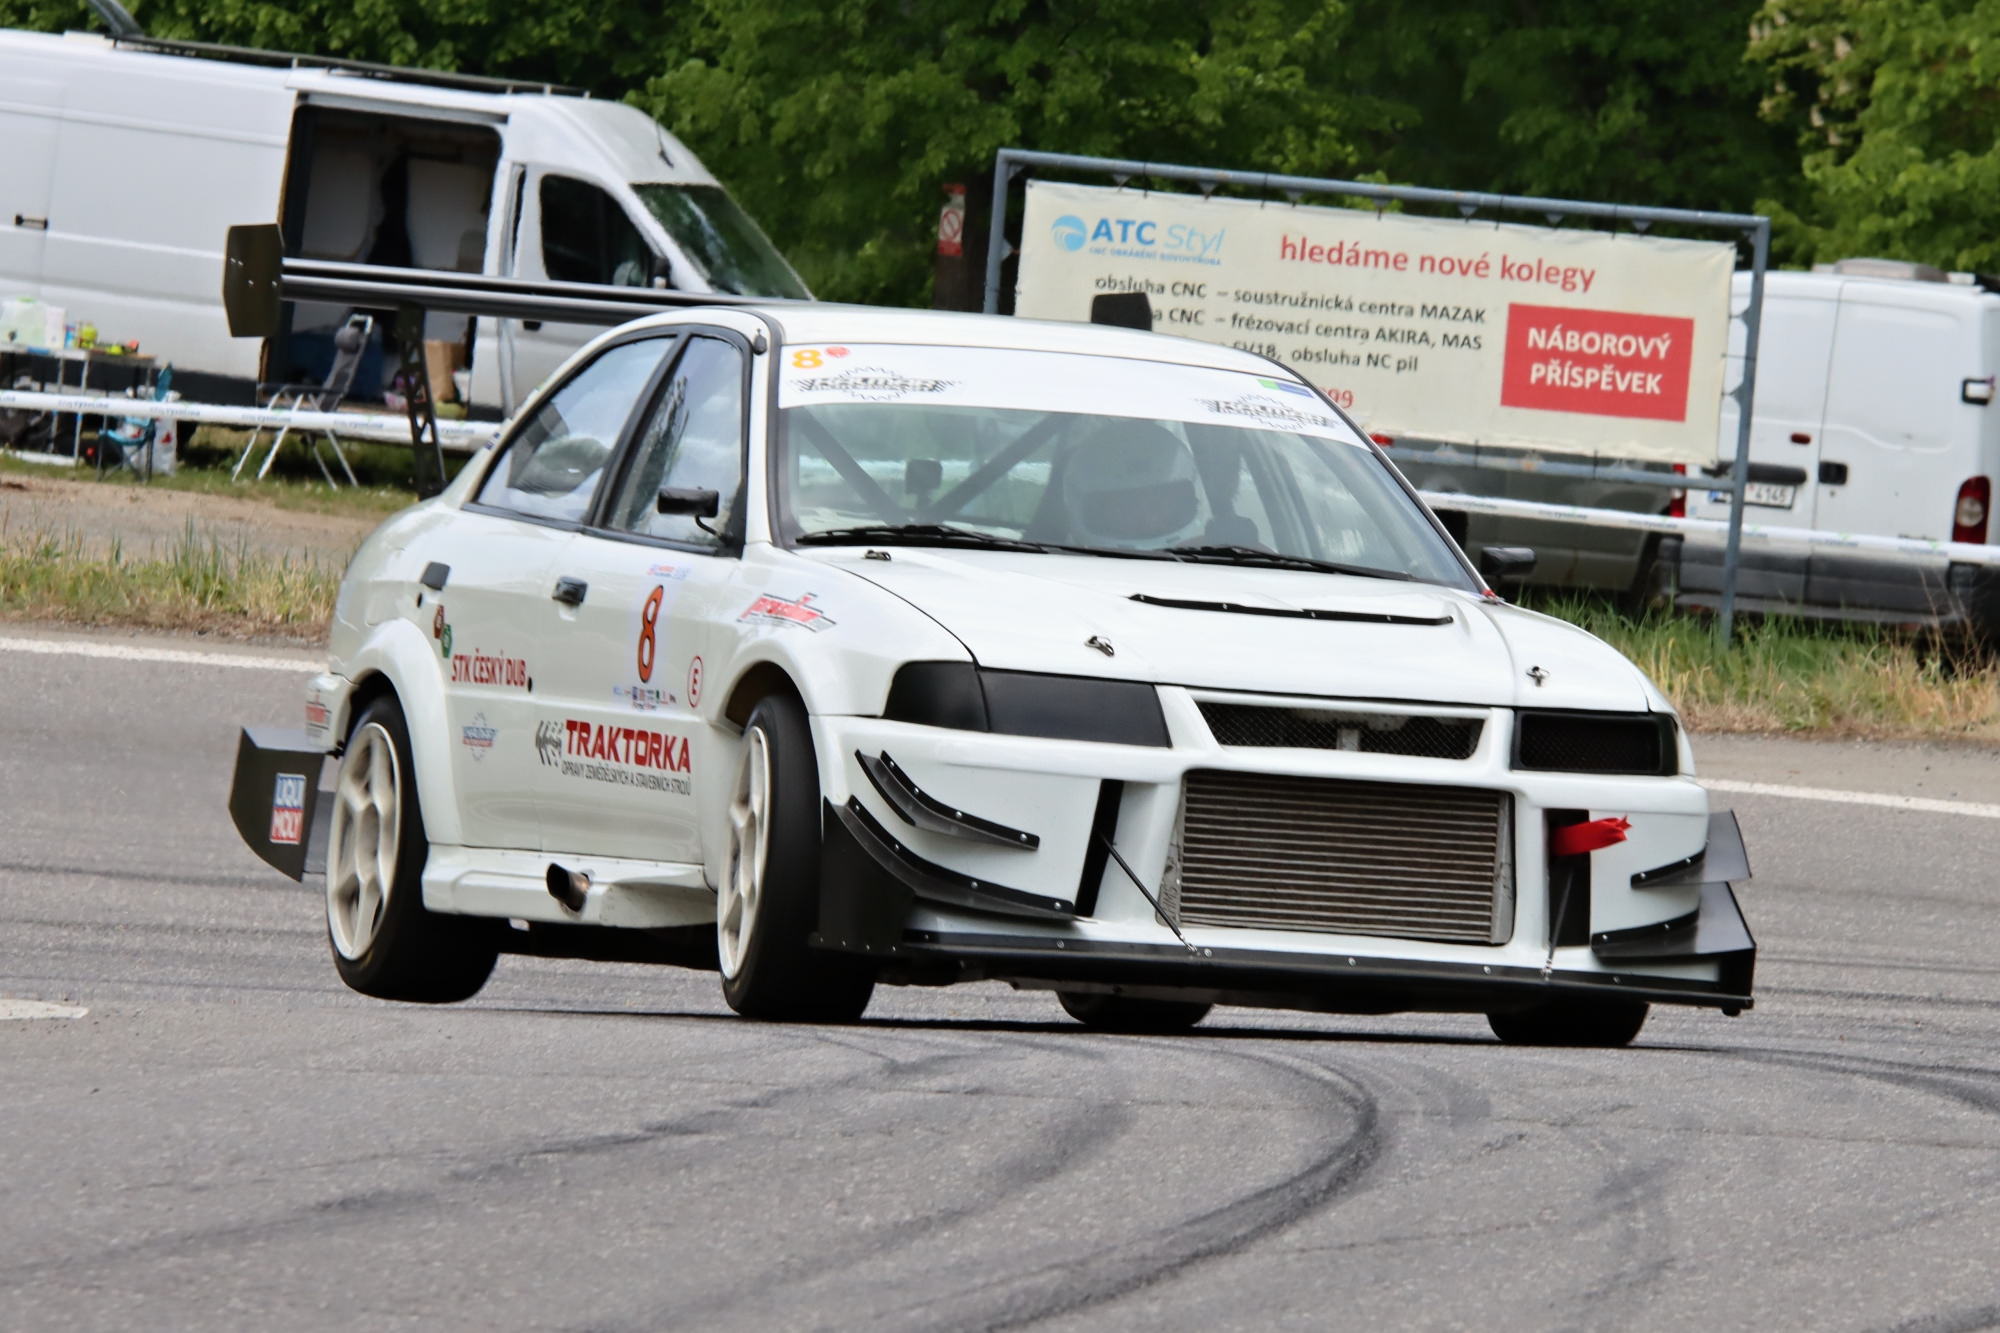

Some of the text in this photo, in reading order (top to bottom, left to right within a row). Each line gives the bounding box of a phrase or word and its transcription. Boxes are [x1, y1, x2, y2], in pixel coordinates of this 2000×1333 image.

[1091, 217, 1227, 258] ATC Styl
[1280, 234, 1597, 294] hledáme nové kolegy
[1095, 274, 1166, 295] obsluha
[1171, 281, 1208, 298] CNC
[1233, 288, 1354, 312] soustružnická
[1358, 300, 1414, 319] centra
[1420, 304, 1487, 324] MAZAK
[1169, 308, 1206, 325] CNC
[1231, 313, 1311, 335] frézovací
[1315, 322, 1370, 343] centra
[1375, 327, 1436, 349] AKIRA,
[1442, 334, 1483, 351] MAS
[1527, 325, 1673, 361] NÁBOROVÝ
[792, 349, 824, 369] 8
[1291, 347, 1361, 369] obsluha
[1367, 354, 1392, 371] NC
[1396, 353, 1419, 374] pil
[1530, 359, 1663, 395] PŘÍSPĚVEK
[637, 584, 664, 684] 8
[451, 647, 527, 687] STK ČESKÝ DUB
[566, 719, 692, 774] TRAKTORKA
